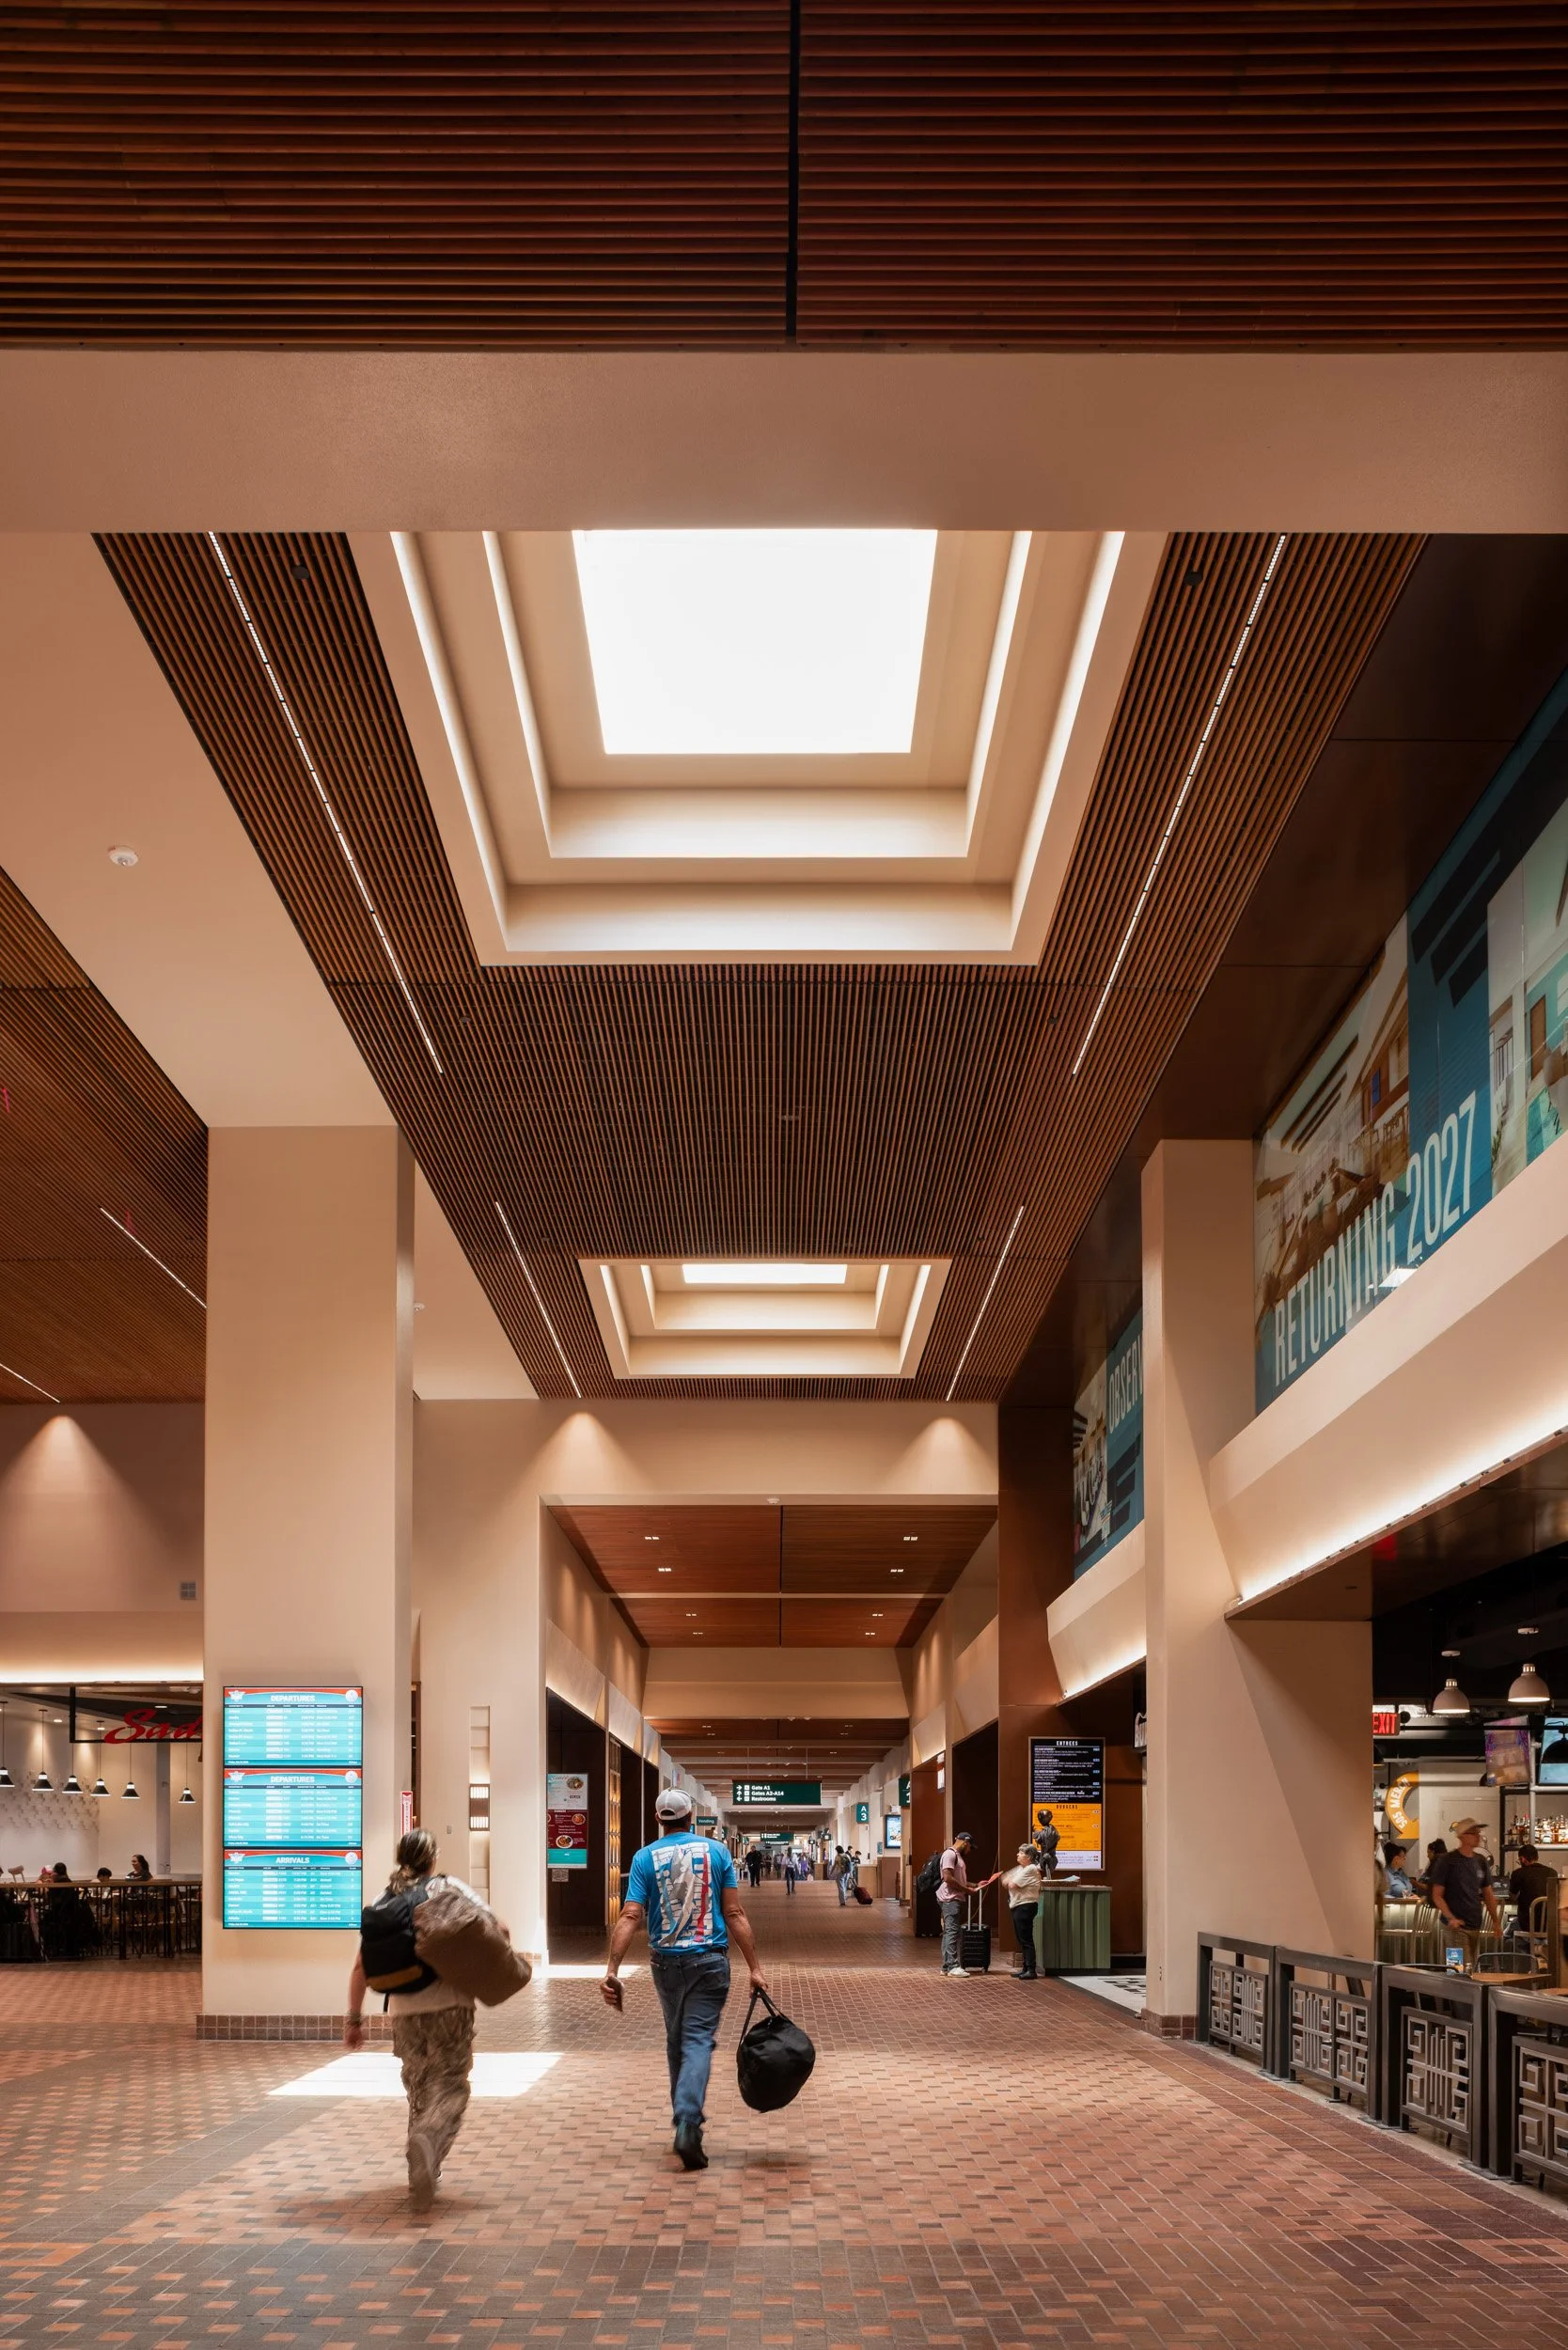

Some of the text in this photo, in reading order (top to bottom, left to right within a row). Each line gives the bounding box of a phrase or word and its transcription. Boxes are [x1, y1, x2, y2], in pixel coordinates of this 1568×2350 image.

[1275, 1089, 1477, 1386] RETURNING 2027
[1372, 1713, 1398, 1734] EXIT
[1389, 1777, 1411, 1809] MERCH
[860, 1812, 867, 1821] 3
